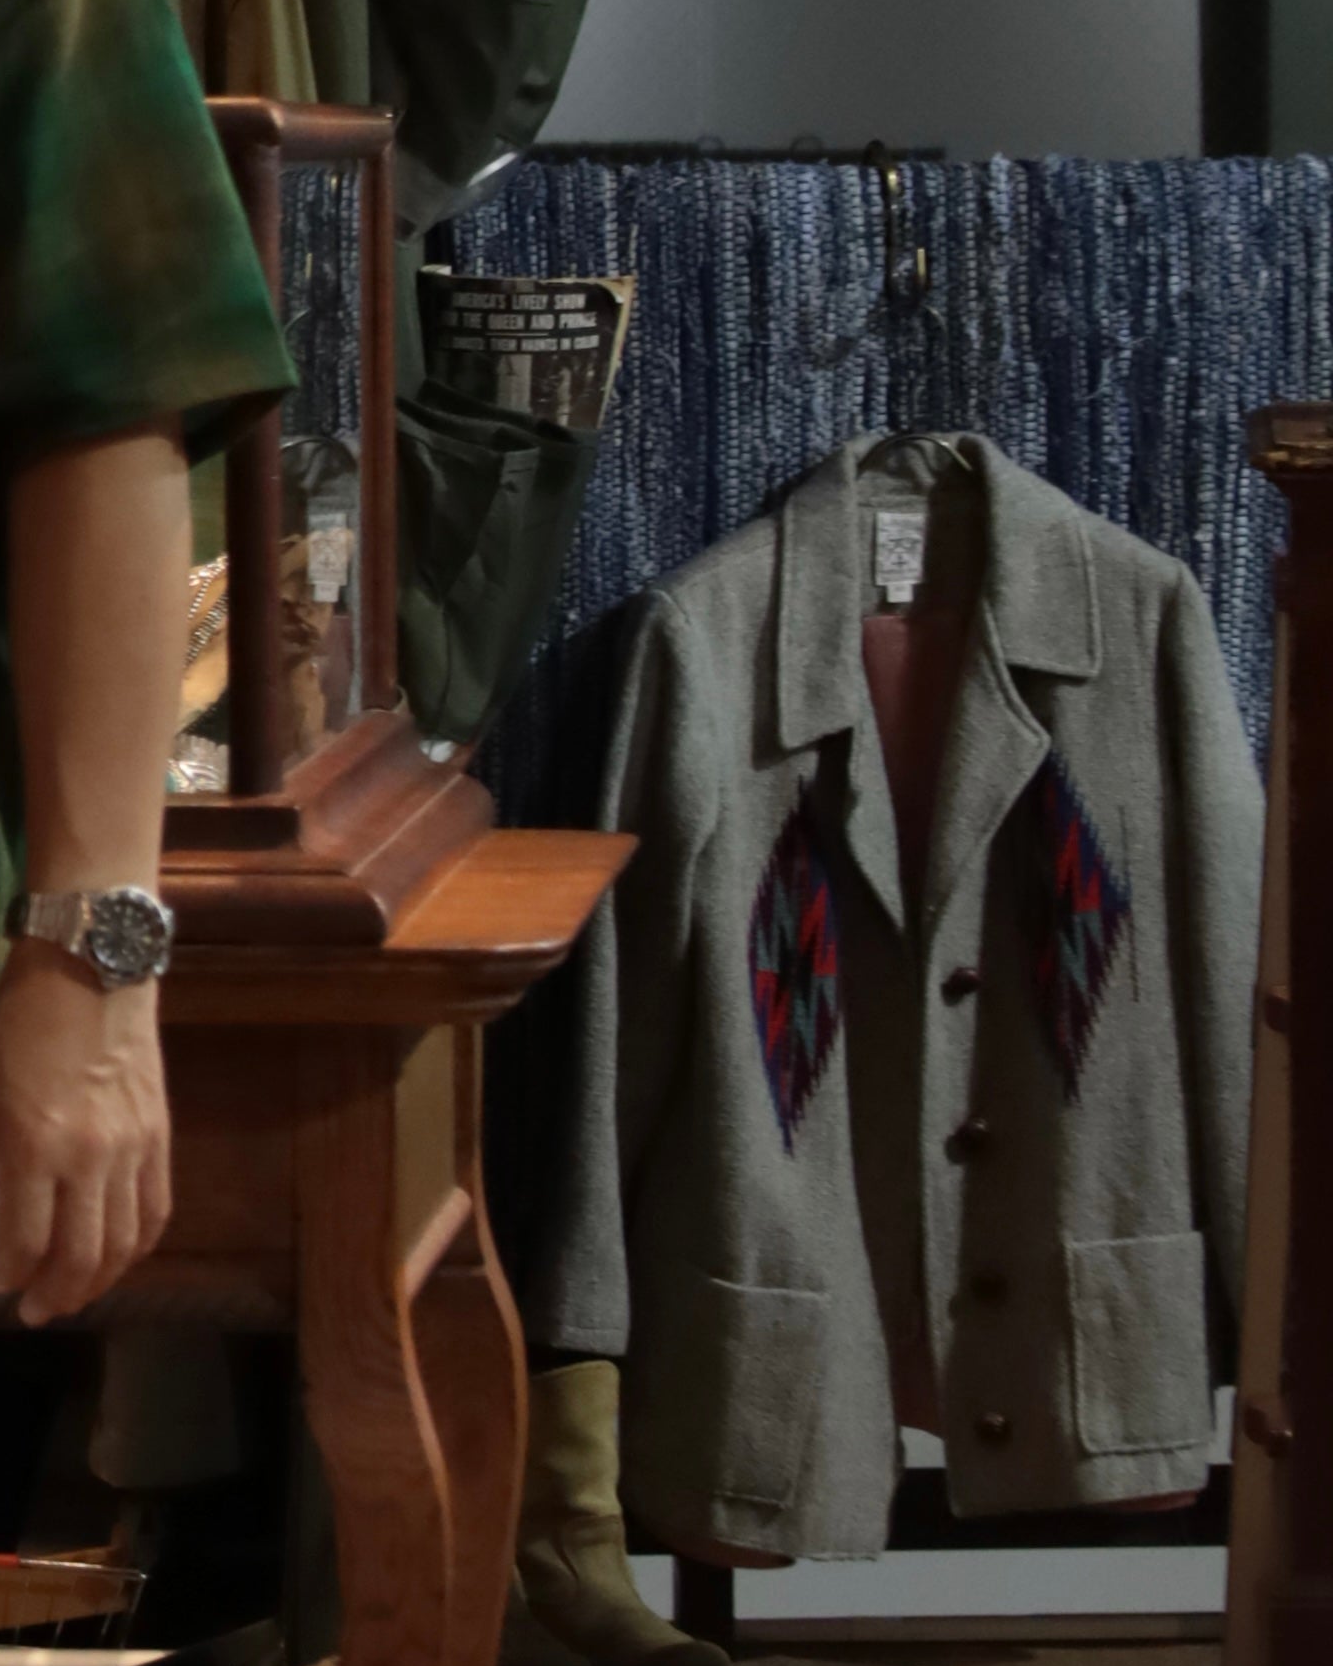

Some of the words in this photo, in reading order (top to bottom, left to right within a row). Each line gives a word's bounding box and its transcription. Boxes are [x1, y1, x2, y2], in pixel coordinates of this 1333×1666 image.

[511, 293, 549, 311] LIVELY
[554, 293, 587, 310] SHOW
[487, 313, 526, 330] QUEEN
[529, 313, 555, 330] AND
